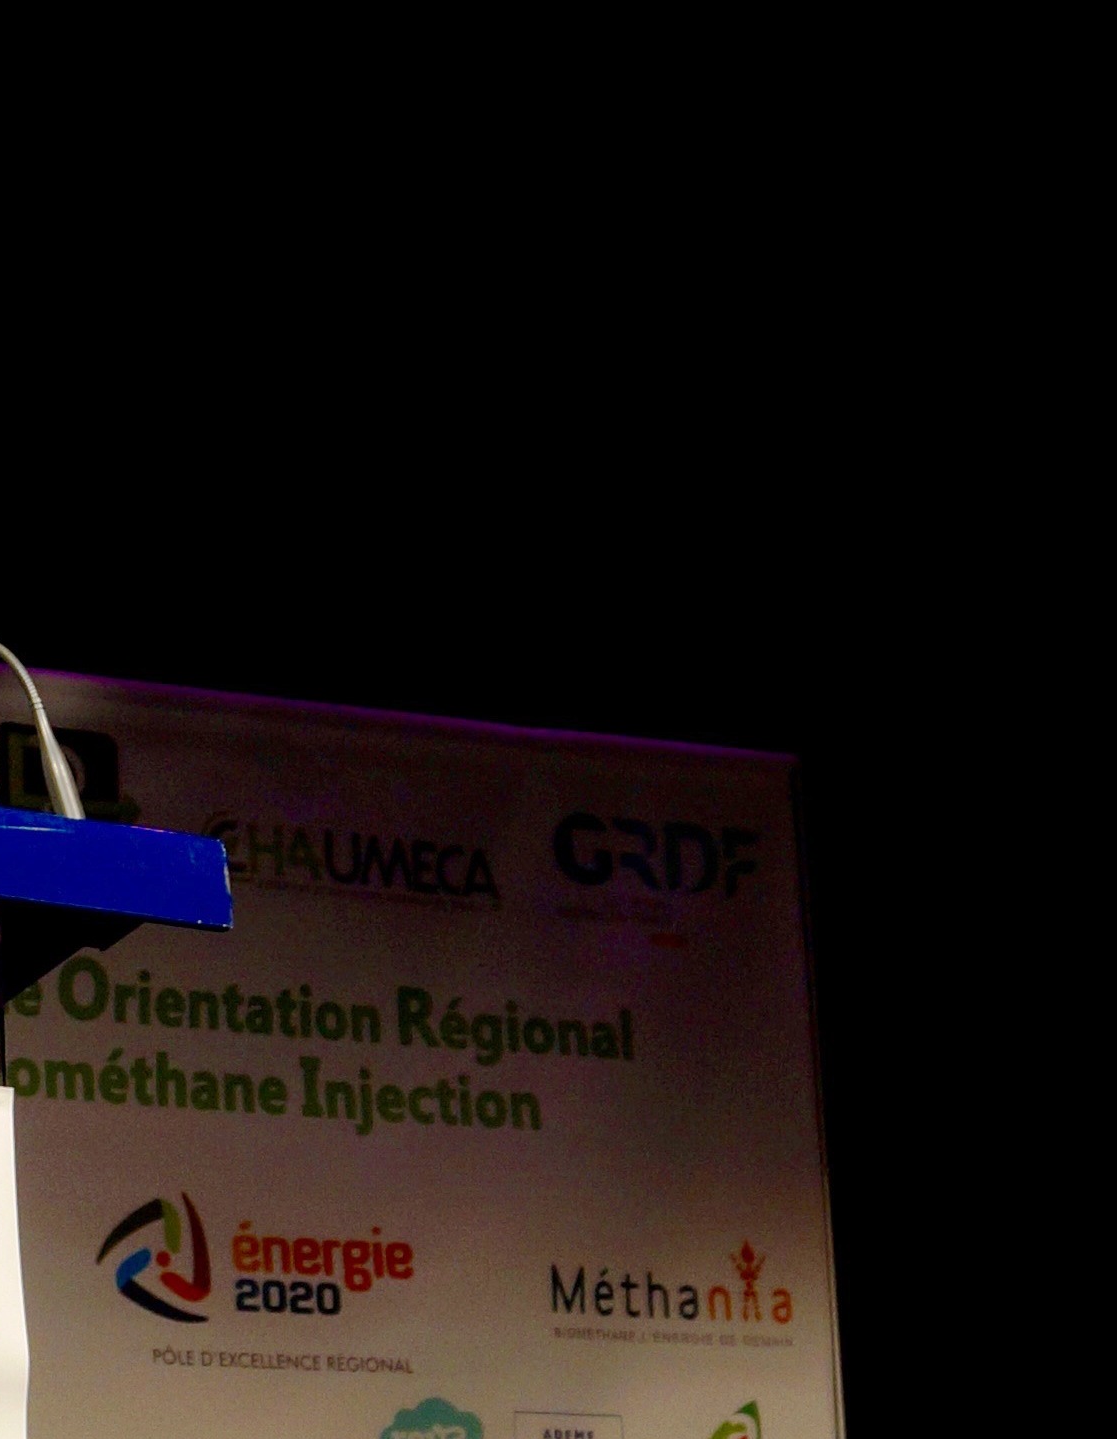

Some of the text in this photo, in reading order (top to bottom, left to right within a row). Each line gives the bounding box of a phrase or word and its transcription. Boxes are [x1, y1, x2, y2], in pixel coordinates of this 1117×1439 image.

[553, 811, 759, 896] GRDF
[58, 956, 381, 1043] Orientation
[397, 986, 635, 1067] Régional
[299, 1056, 542, 1136] Injection
[232, 1220, 414, 1292] énergie
[235, 1278, 342, 1315] 2020
[152, 1346, 195, 1367] PÔLE
